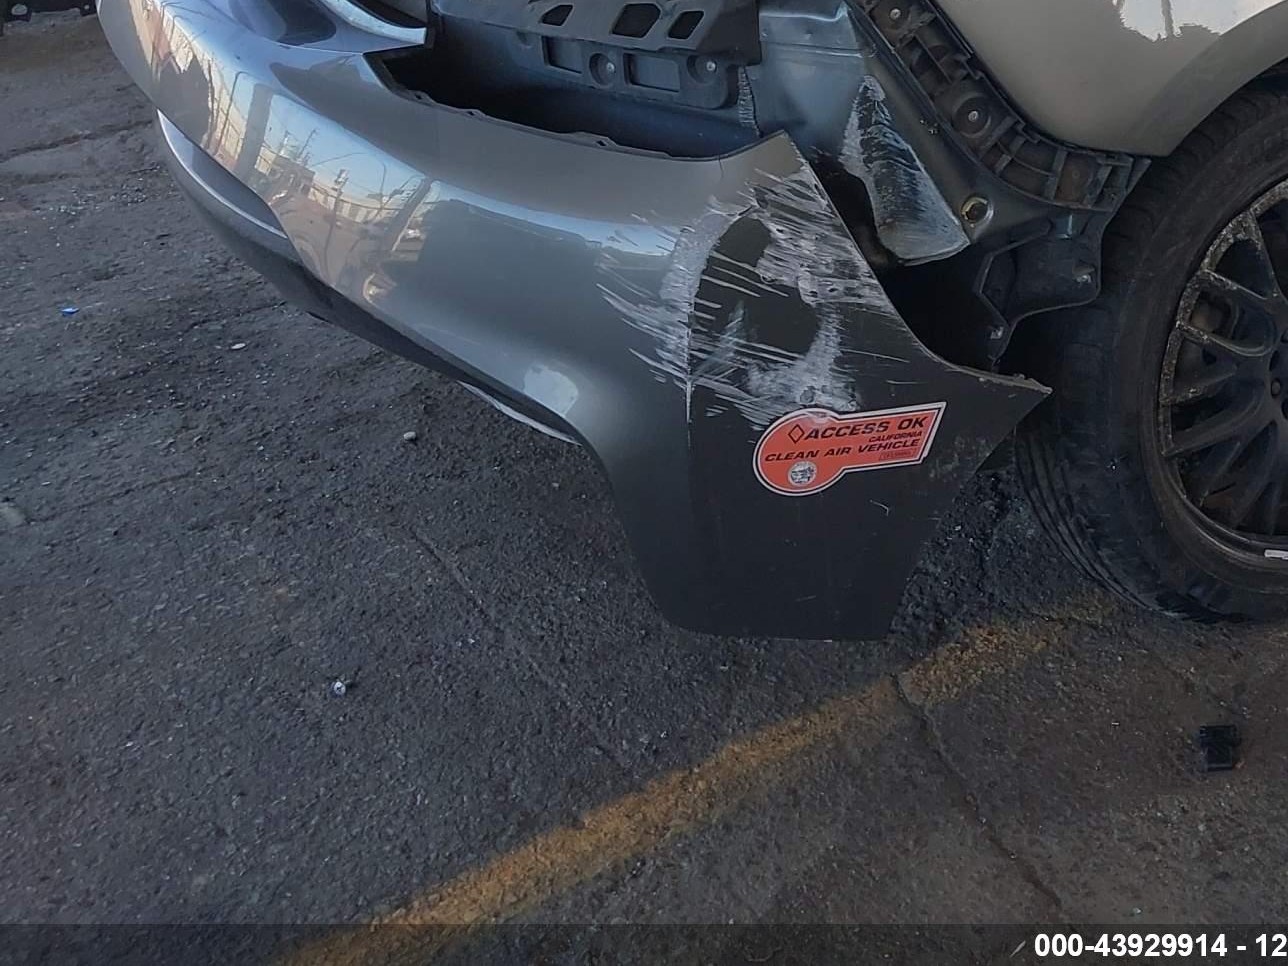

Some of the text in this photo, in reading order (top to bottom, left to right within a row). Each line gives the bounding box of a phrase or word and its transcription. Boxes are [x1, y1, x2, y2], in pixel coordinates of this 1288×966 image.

[804, 416, 928, 440] ACCESS OK
[868, 430, 922, 443] CALIFORNIA
[765, 438, 920, 462] CLEAN AIR VEHICLE
